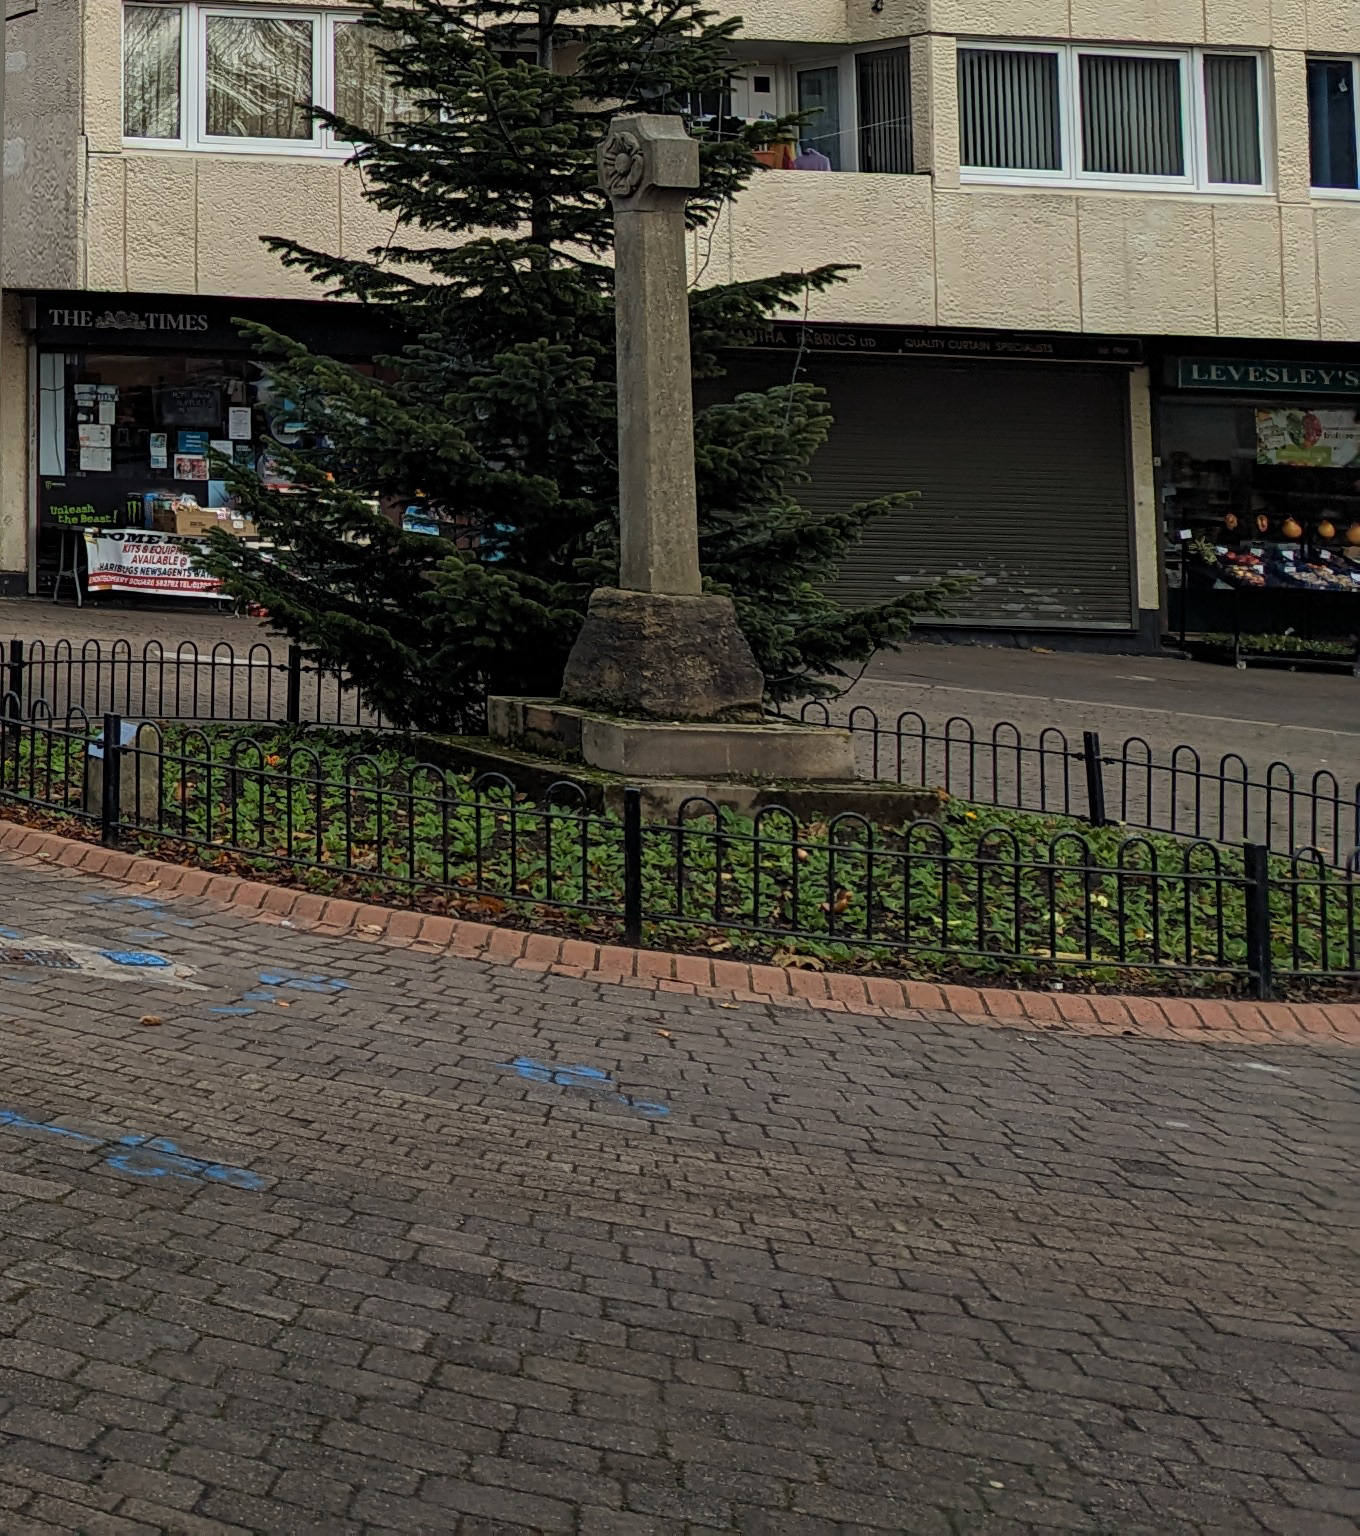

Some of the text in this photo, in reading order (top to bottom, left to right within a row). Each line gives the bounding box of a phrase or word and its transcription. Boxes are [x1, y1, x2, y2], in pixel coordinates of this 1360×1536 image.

[48, 309, 209, 331] THE TIMES
[796, 332, 857, 347] FABRICS
[904, 337, 945, 349] QUALITY
[1191, 364, 1359, 386] LEVESLEY'S
[49, 504, 95, 516] Unleash
[58, 510, 119, 524] the Beast!
[122, 545, 142, 555] KITS
[131, 555, 188, 568] AVAILABLE @
[139, 566, 193, 579] NEWSAGENTS
